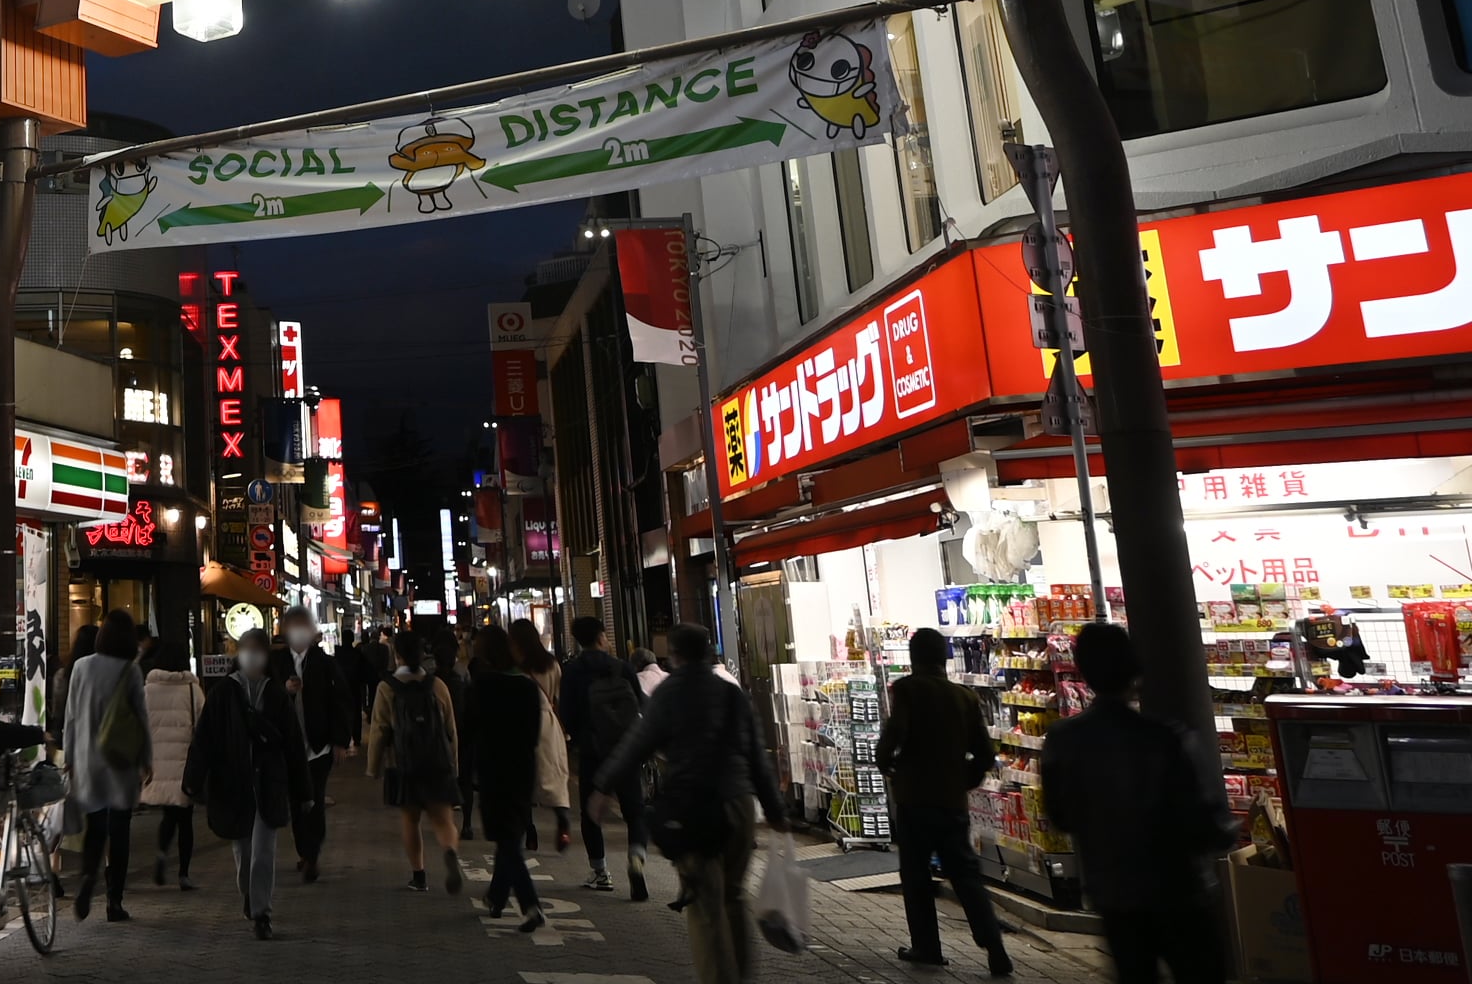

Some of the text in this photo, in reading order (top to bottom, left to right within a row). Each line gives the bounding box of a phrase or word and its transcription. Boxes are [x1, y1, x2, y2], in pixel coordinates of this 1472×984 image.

[187, 55, 760, 185] SOCIAL DISTANCE
[602, 137, 651, 167] 2m
[253, 194, 285, 217] 2m
[1197, 209, 1472, 352] サン
[675, 308, 701, 367] 2020
[892, 312, 919, 341] DRUG
[905, 345, 914, 365] &
[761, 320, 885, 467] サンドラッグ
[895, 366, 930, 398] COSMETIC
[725, 407, 745, 479] 薬
[525, 520, 558, 533] Liqur
[257, 577, 271, 591] 20
[1191, 557, 1320, 586] ペット用品
[1376, 819, 1412, 838] 郵便
[1381, 851, 1416, 868] POST
[1400, 947, 1460, 966] 日本郵便
